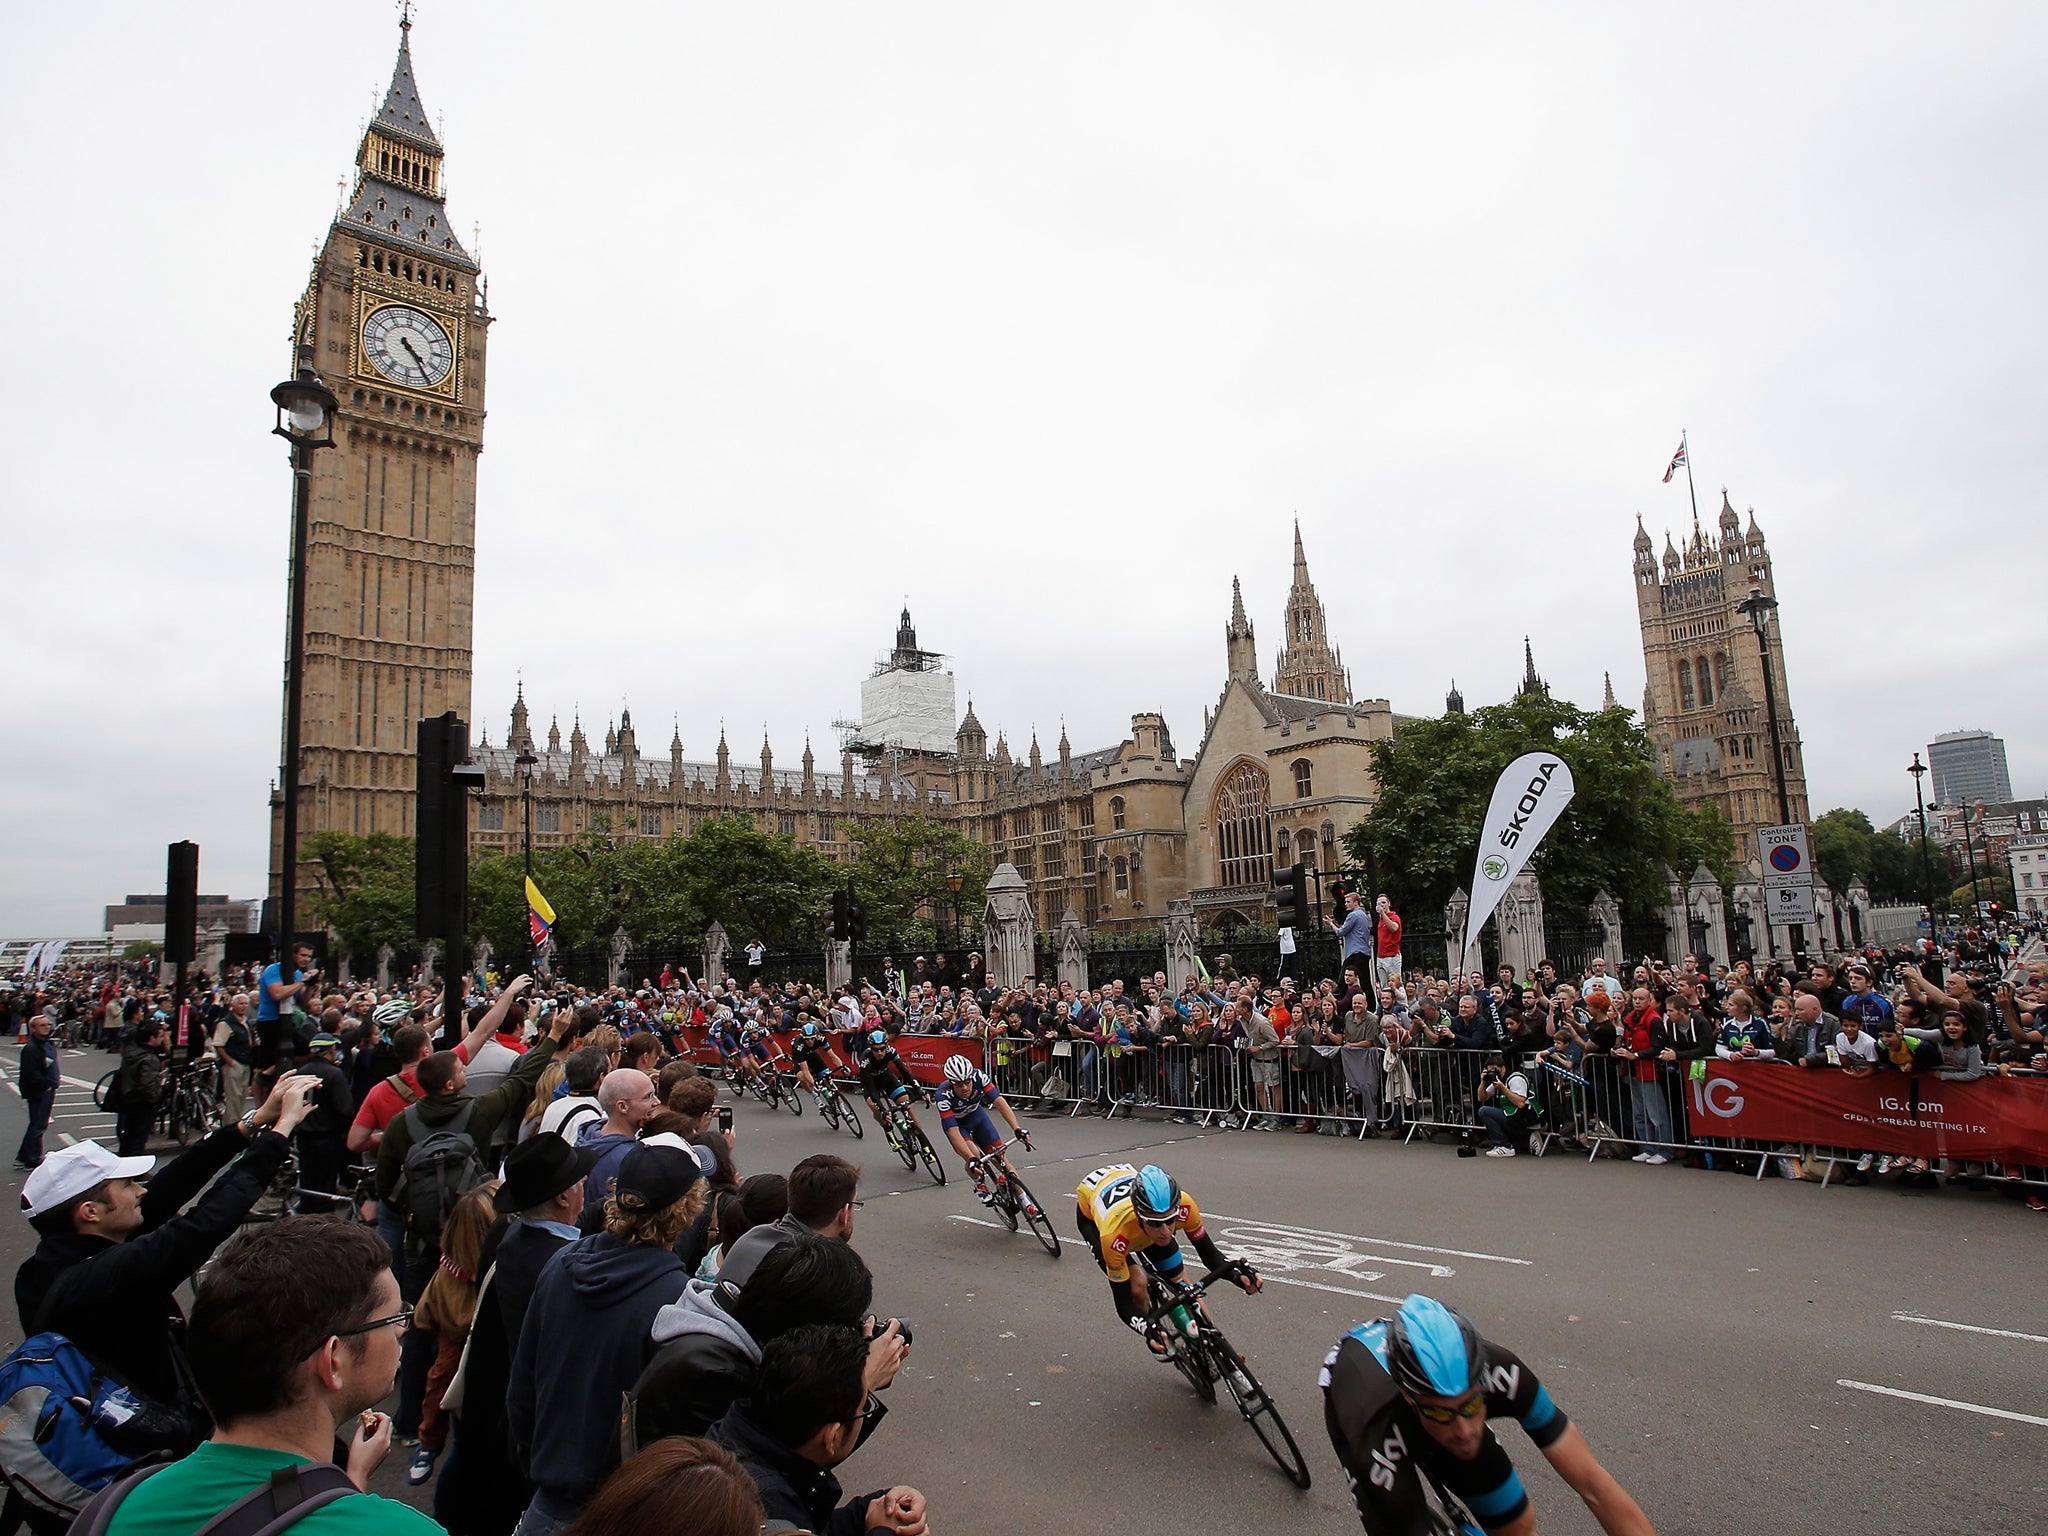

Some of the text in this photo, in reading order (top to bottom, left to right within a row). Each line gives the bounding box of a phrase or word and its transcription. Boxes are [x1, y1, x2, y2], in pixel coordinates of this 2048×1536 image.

[1498, 763, 1559, 850] ŠKODA
[1760, 825, 1802, 836] Controlled
[1767, 834, 1797, 844] ZONE
[911, 1051, 934, 1060] IG.com
[1692, 1077, 1745, 1118] IG
[1877, 1117, 1917, 1127] SPREAD
[1920, 1120, 1963, 1132] BETTING
[1972, 1126, 1987, 1134] FX
[1112, 1238, 1127, 1253] IG
